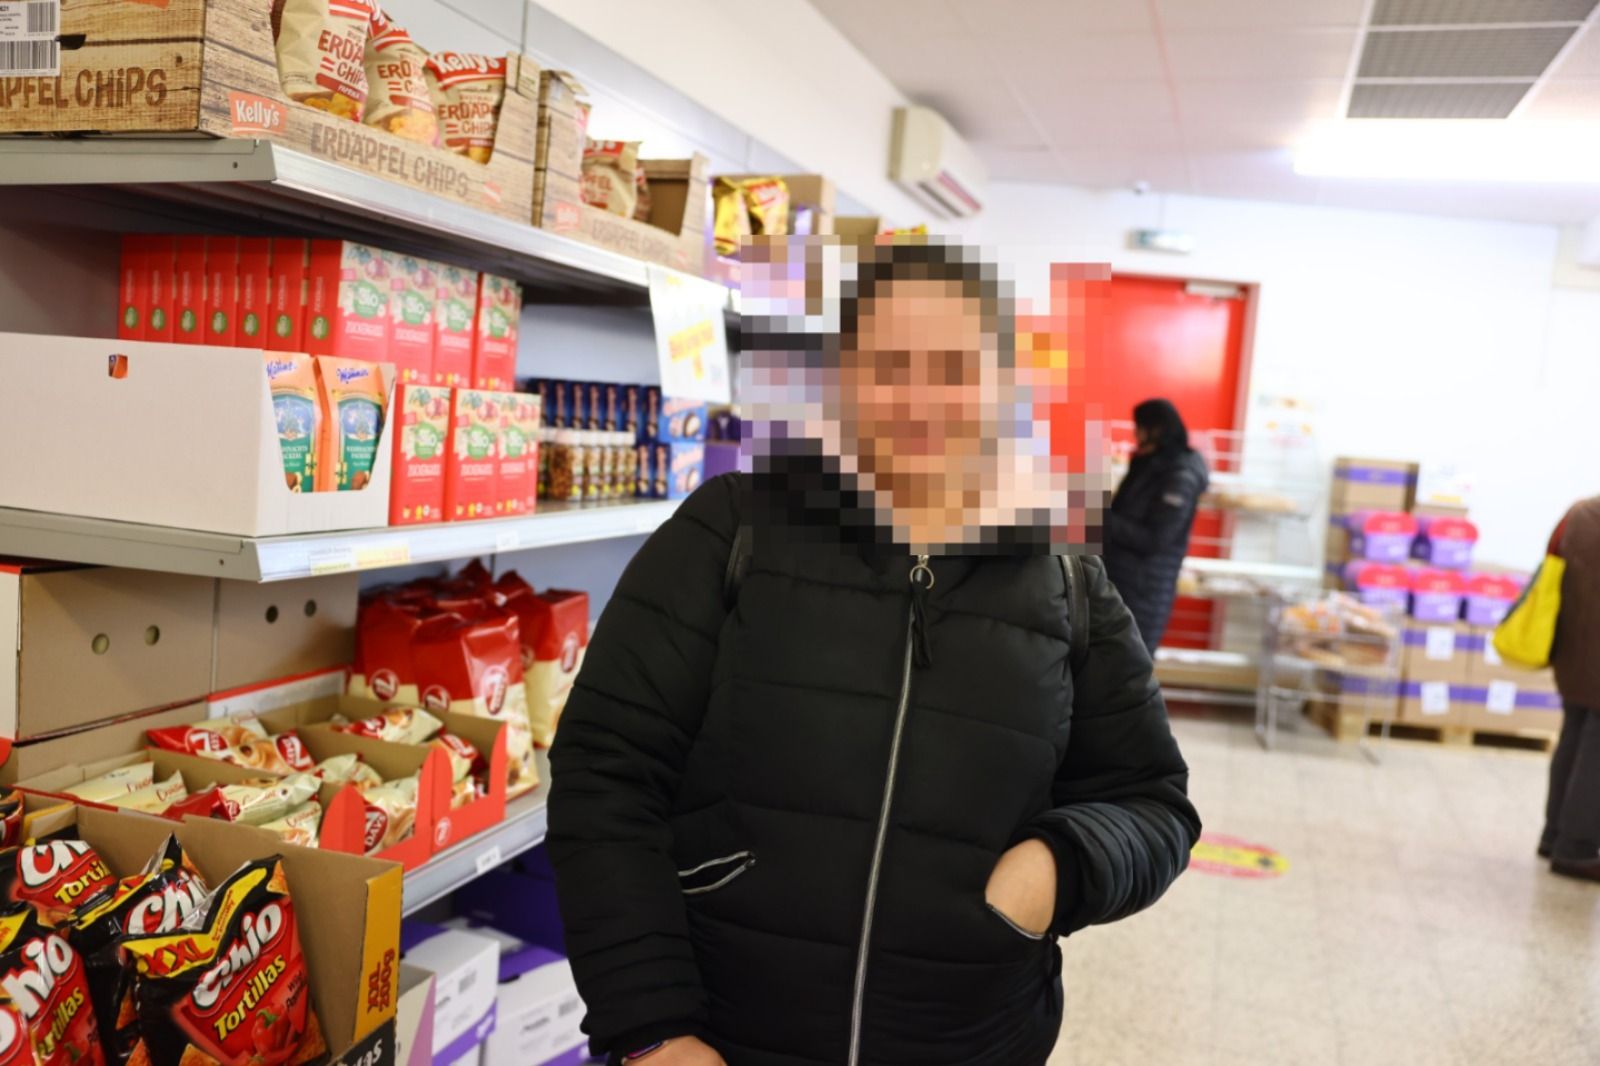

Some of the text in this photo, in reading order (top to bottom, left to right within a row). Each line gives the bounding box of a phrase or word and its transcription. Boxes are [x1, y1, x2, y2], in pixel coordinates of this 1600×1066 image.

[0, 76, 69, 109] PFEL
[235, 100, 280, 129] Kelly's
[193, 904, 282, 1008] Chio
[214, 954, 286, 1041] Tortillas
